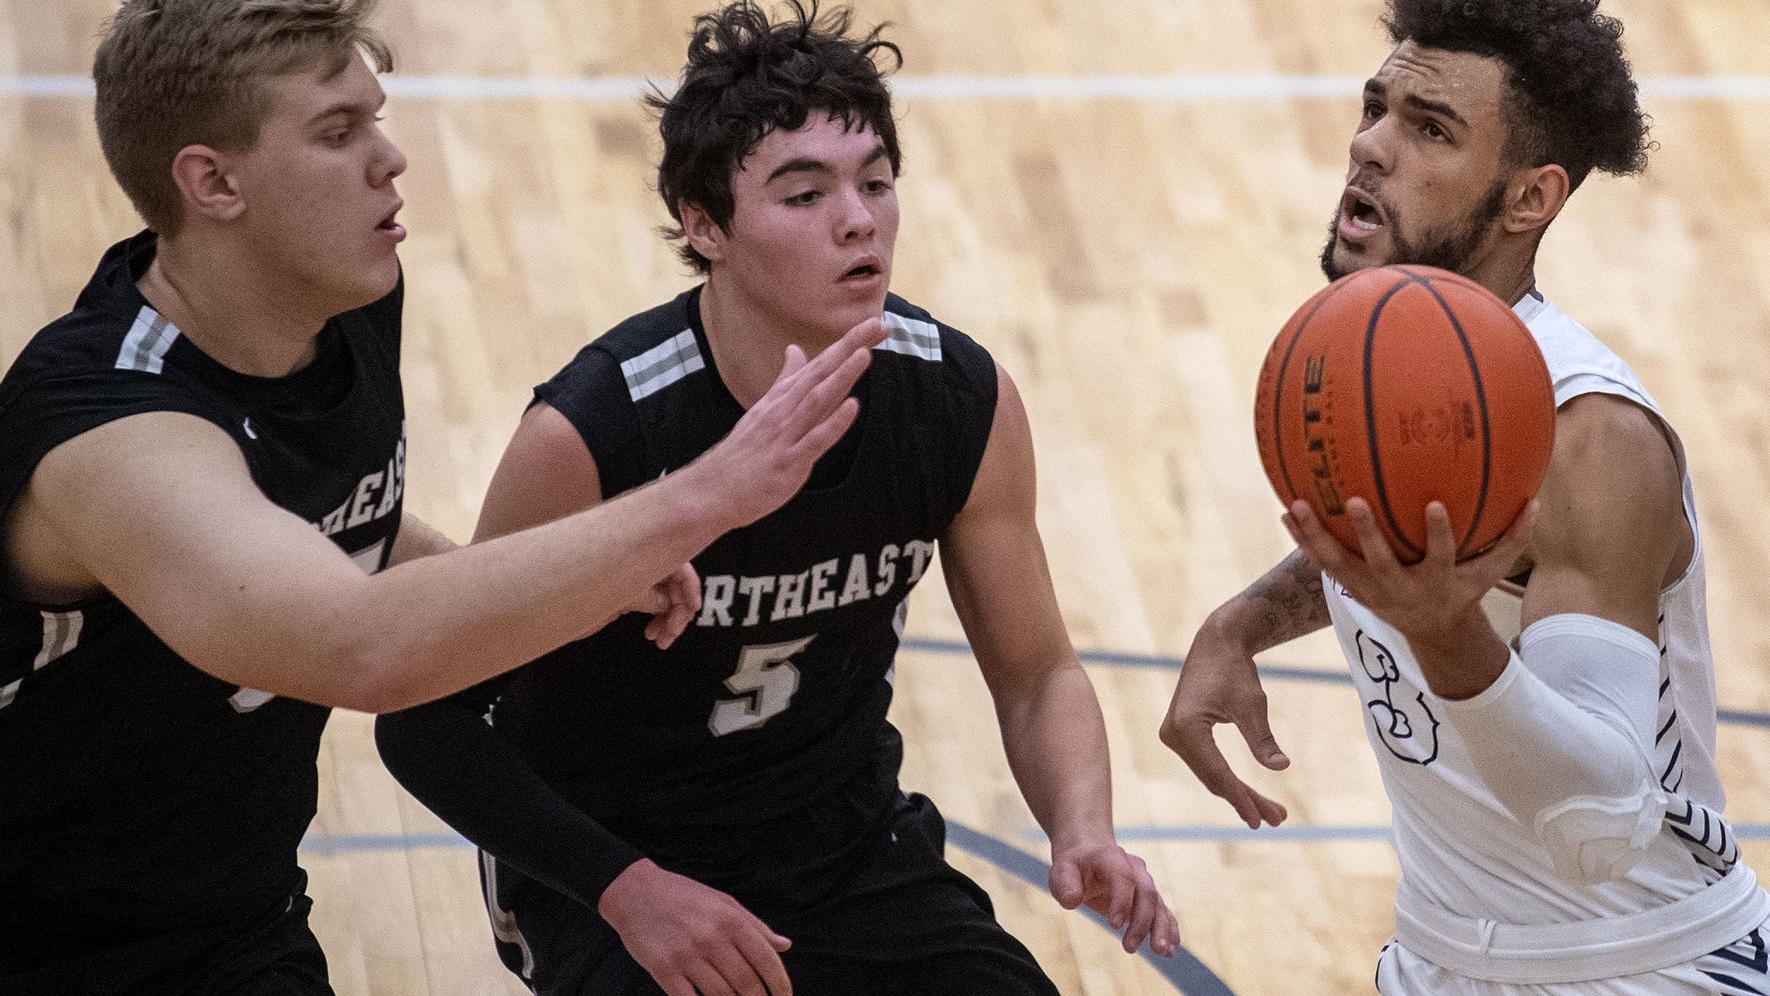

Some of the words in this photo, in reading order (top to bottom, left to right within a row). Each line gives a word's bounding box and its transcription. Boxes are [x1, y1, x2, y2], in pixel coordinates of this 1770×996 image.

[1303, 355, 1344, 516] ELITE
[696, 539, 934, 627] RTHEAST
[707, 633, 818, 738] 5
